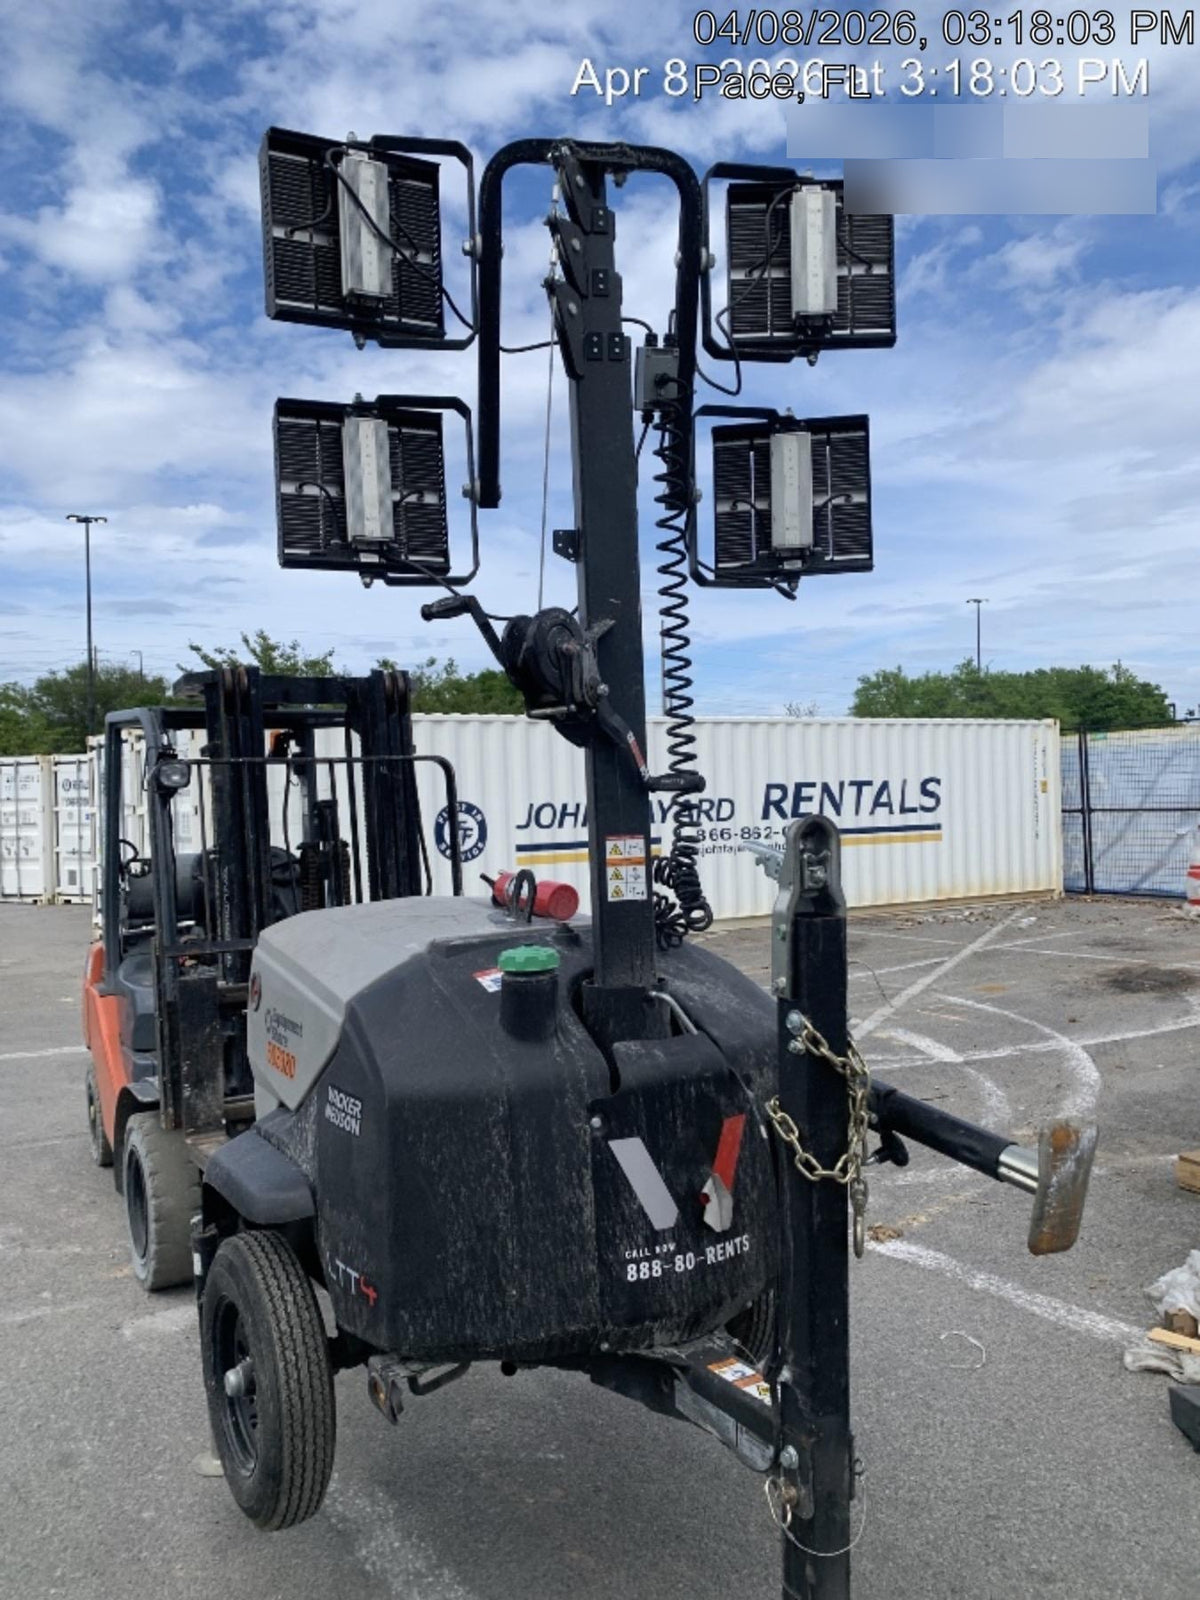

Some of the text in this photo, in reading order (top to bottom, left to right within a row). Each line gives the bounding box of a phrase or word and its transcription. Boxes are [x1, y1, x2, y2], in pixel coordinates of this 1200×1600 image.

[649, 797, 735, 824] YARD
[761, 776, 942, 820] RENTALS
[625, 1248, 651, 1260] CALL
[626, 1234, 751, 1283] 888-80-RENTS
